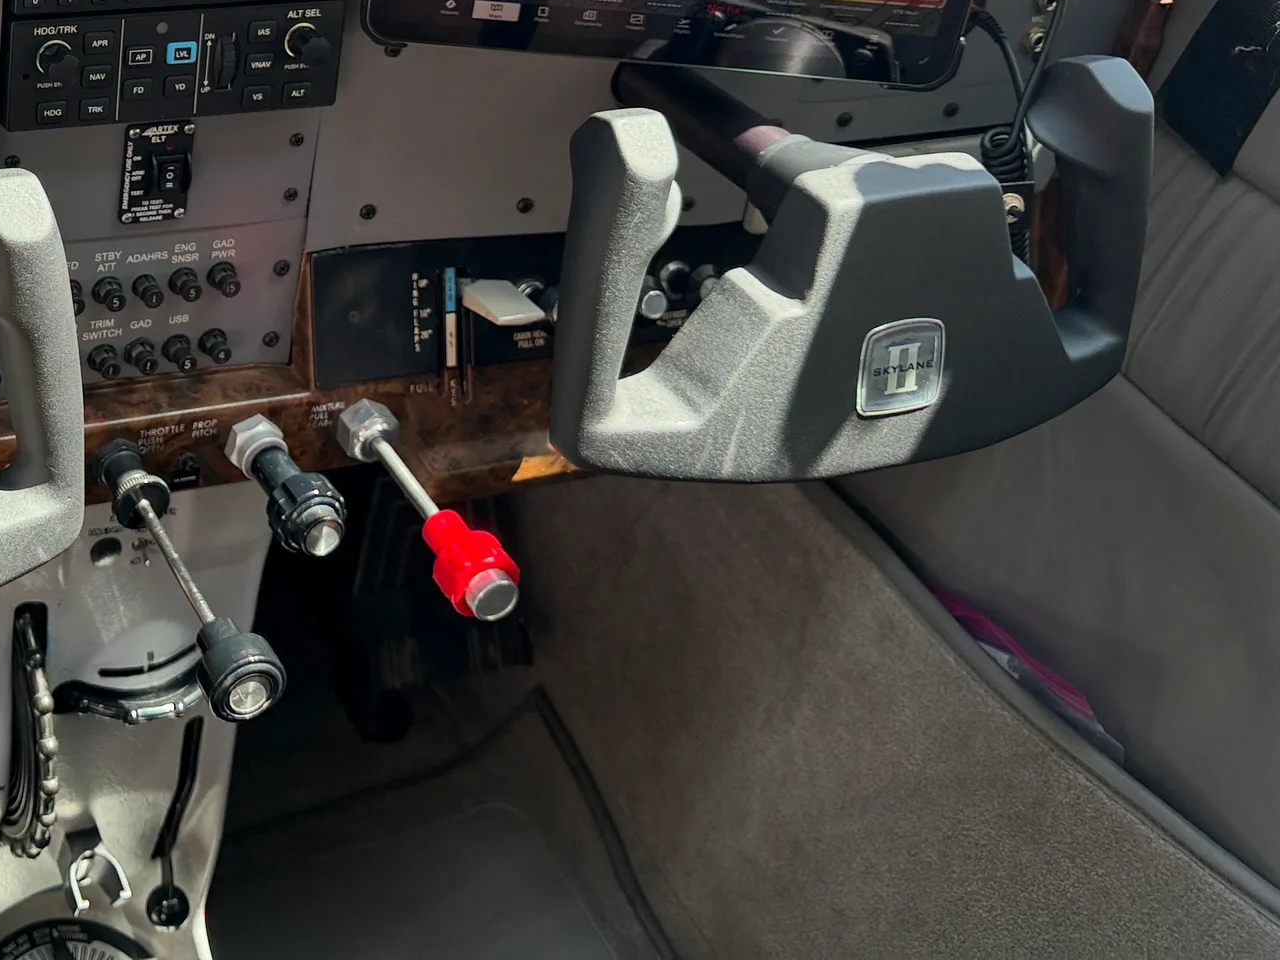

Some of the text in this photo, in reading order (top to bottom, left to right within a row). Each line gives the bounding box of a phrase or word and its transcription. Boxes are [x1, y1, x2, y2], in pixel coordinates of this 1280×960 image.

[287, 8, 322, 18] ALT SEL
[34, 25, 78, 36] HDG/TRK
[92, 38, 108, 48] APR
[251, 60, 271, 69] VNAV
[90, 72, 106, 81] NAV
[44, 104, 104, 117] HDG TRK
[212, 238, 235, 249] GAD
[95, 250, 169, 263] STBY ADAHRS
[211, 249, 236, 259] PWR
[90, 319, 115, 330] TRIM
[169, 314, 189, 324] USB
[82, 328, 122, 341] SWITCH
[873, 359, 933, 377] SKYLANE
[140, 419, 218, 438] THROTTLE PROP
